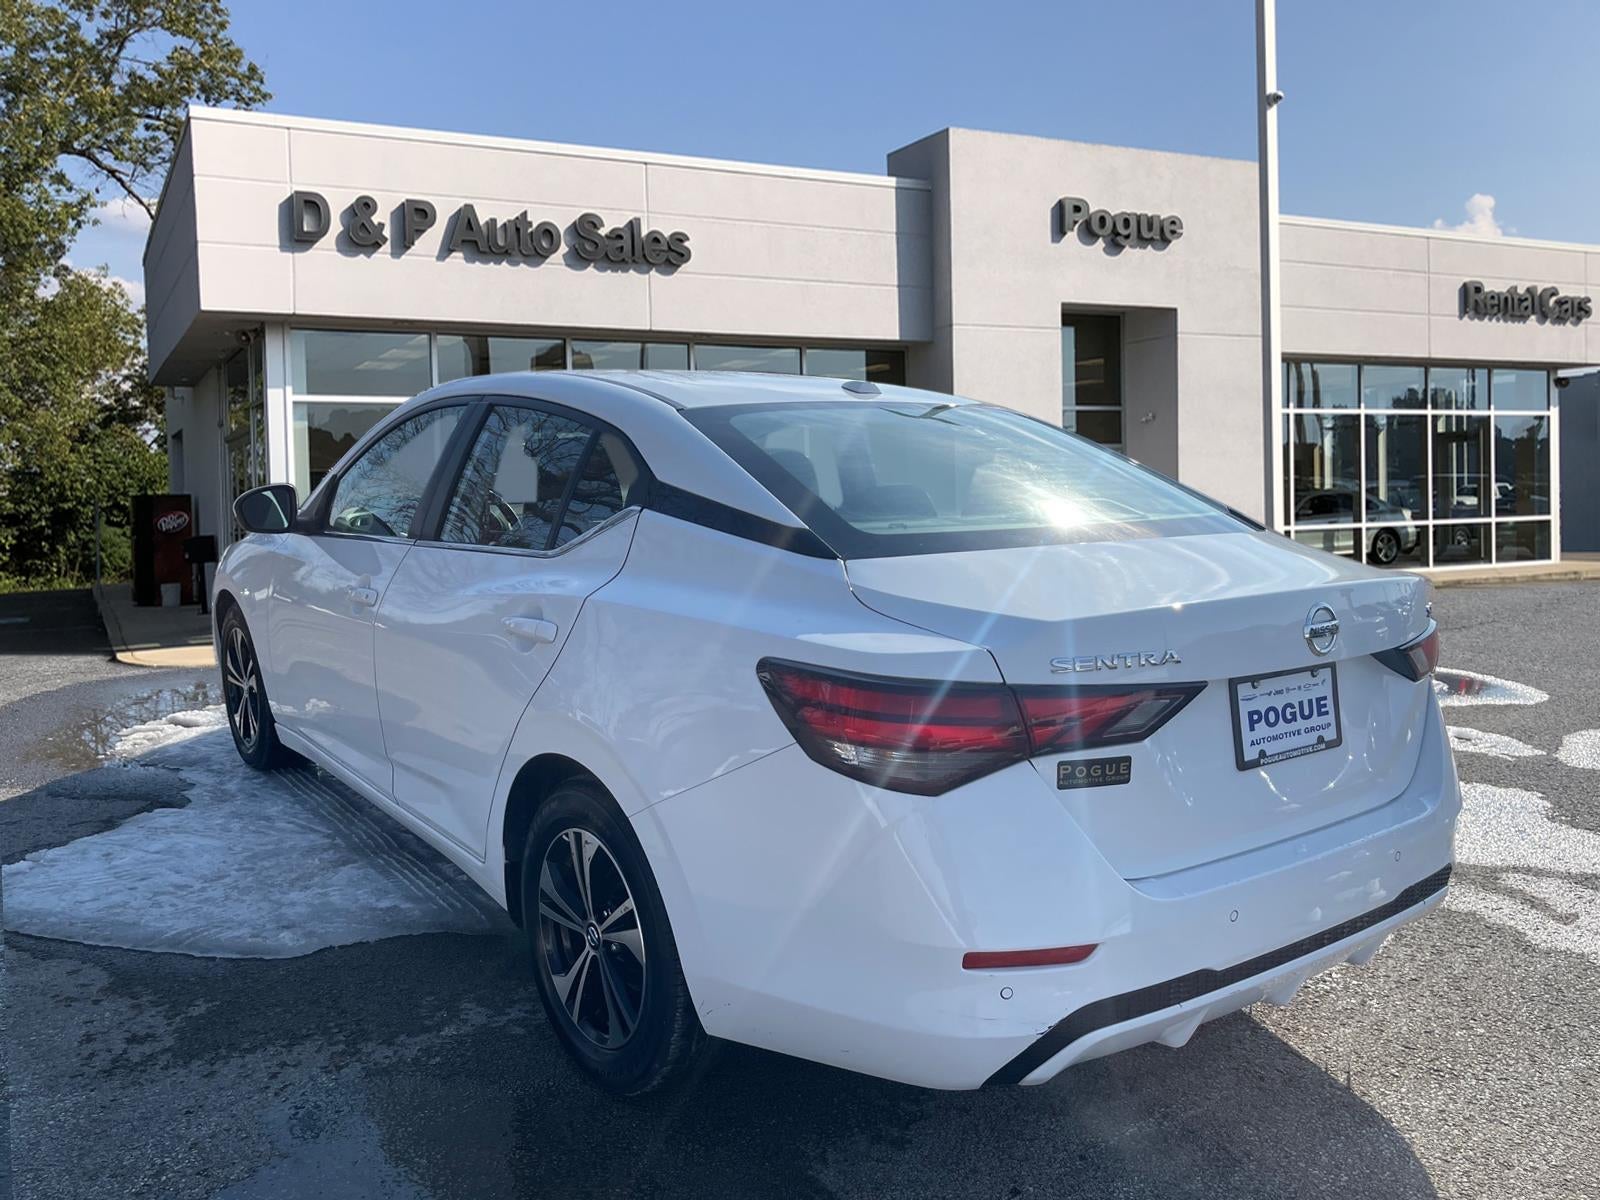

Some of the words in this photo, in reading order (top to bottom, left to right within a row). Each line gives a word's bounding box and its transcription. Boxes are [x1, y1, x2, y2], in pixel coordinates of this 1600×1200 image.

[291, 190, 331, 244] D
[347, 195, 388, 248] &
[402, 198, 437, 248] P
[448, 203, 562, 259] Auto
[573, 211, 692, 267] Sales
[1061, 197, 1184, 247] Pogue
[1465, 280, 1538, 317] Rental
[1540, 286, 1592, 321] Cars
[1050, 649, 1182, 673] SENTRA
[1247, 695, 1330, 732] POGUE
[1250, 728, 1302, 747] AUTOMOTIVE
[1304, 722, 1332, 734] GROUP
[1059, 762, 1130, 779] POGUE
